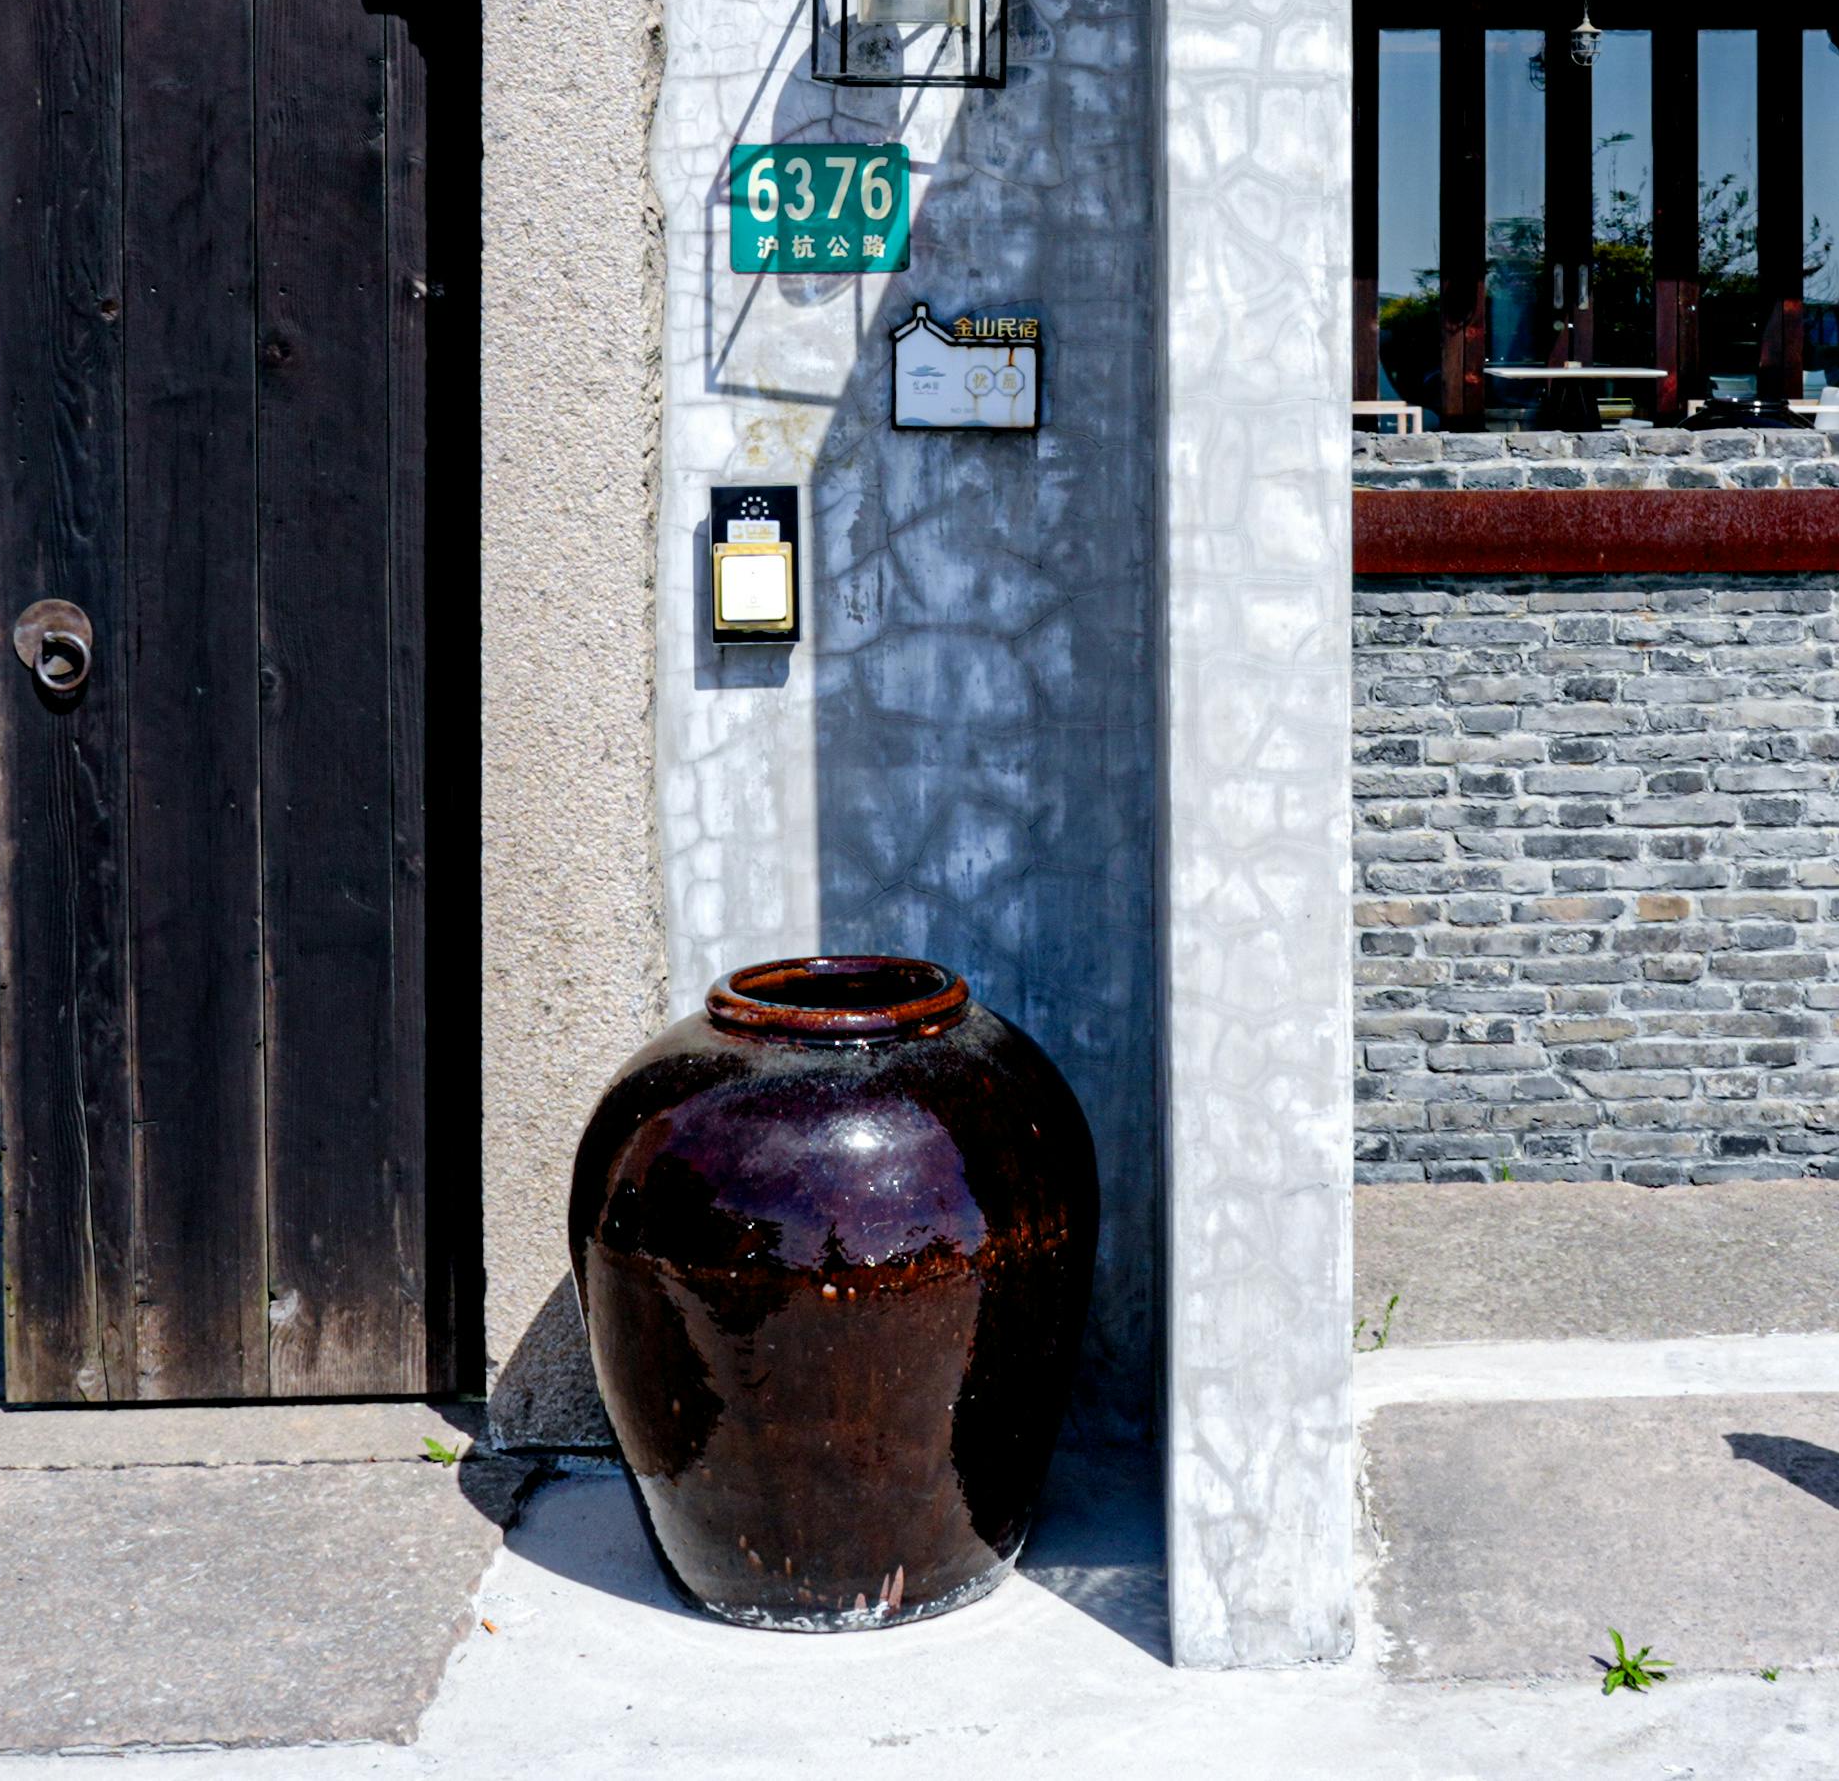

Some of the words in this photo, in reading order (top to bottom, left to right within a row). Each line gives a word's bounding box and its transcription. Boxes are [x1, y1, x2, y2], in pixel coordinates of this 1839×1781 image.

[748, 157, 893, 222] 6376
[757, 234, 886, 259] 沪杭公路
[953, 317, 1038, 338] 金山民宿
